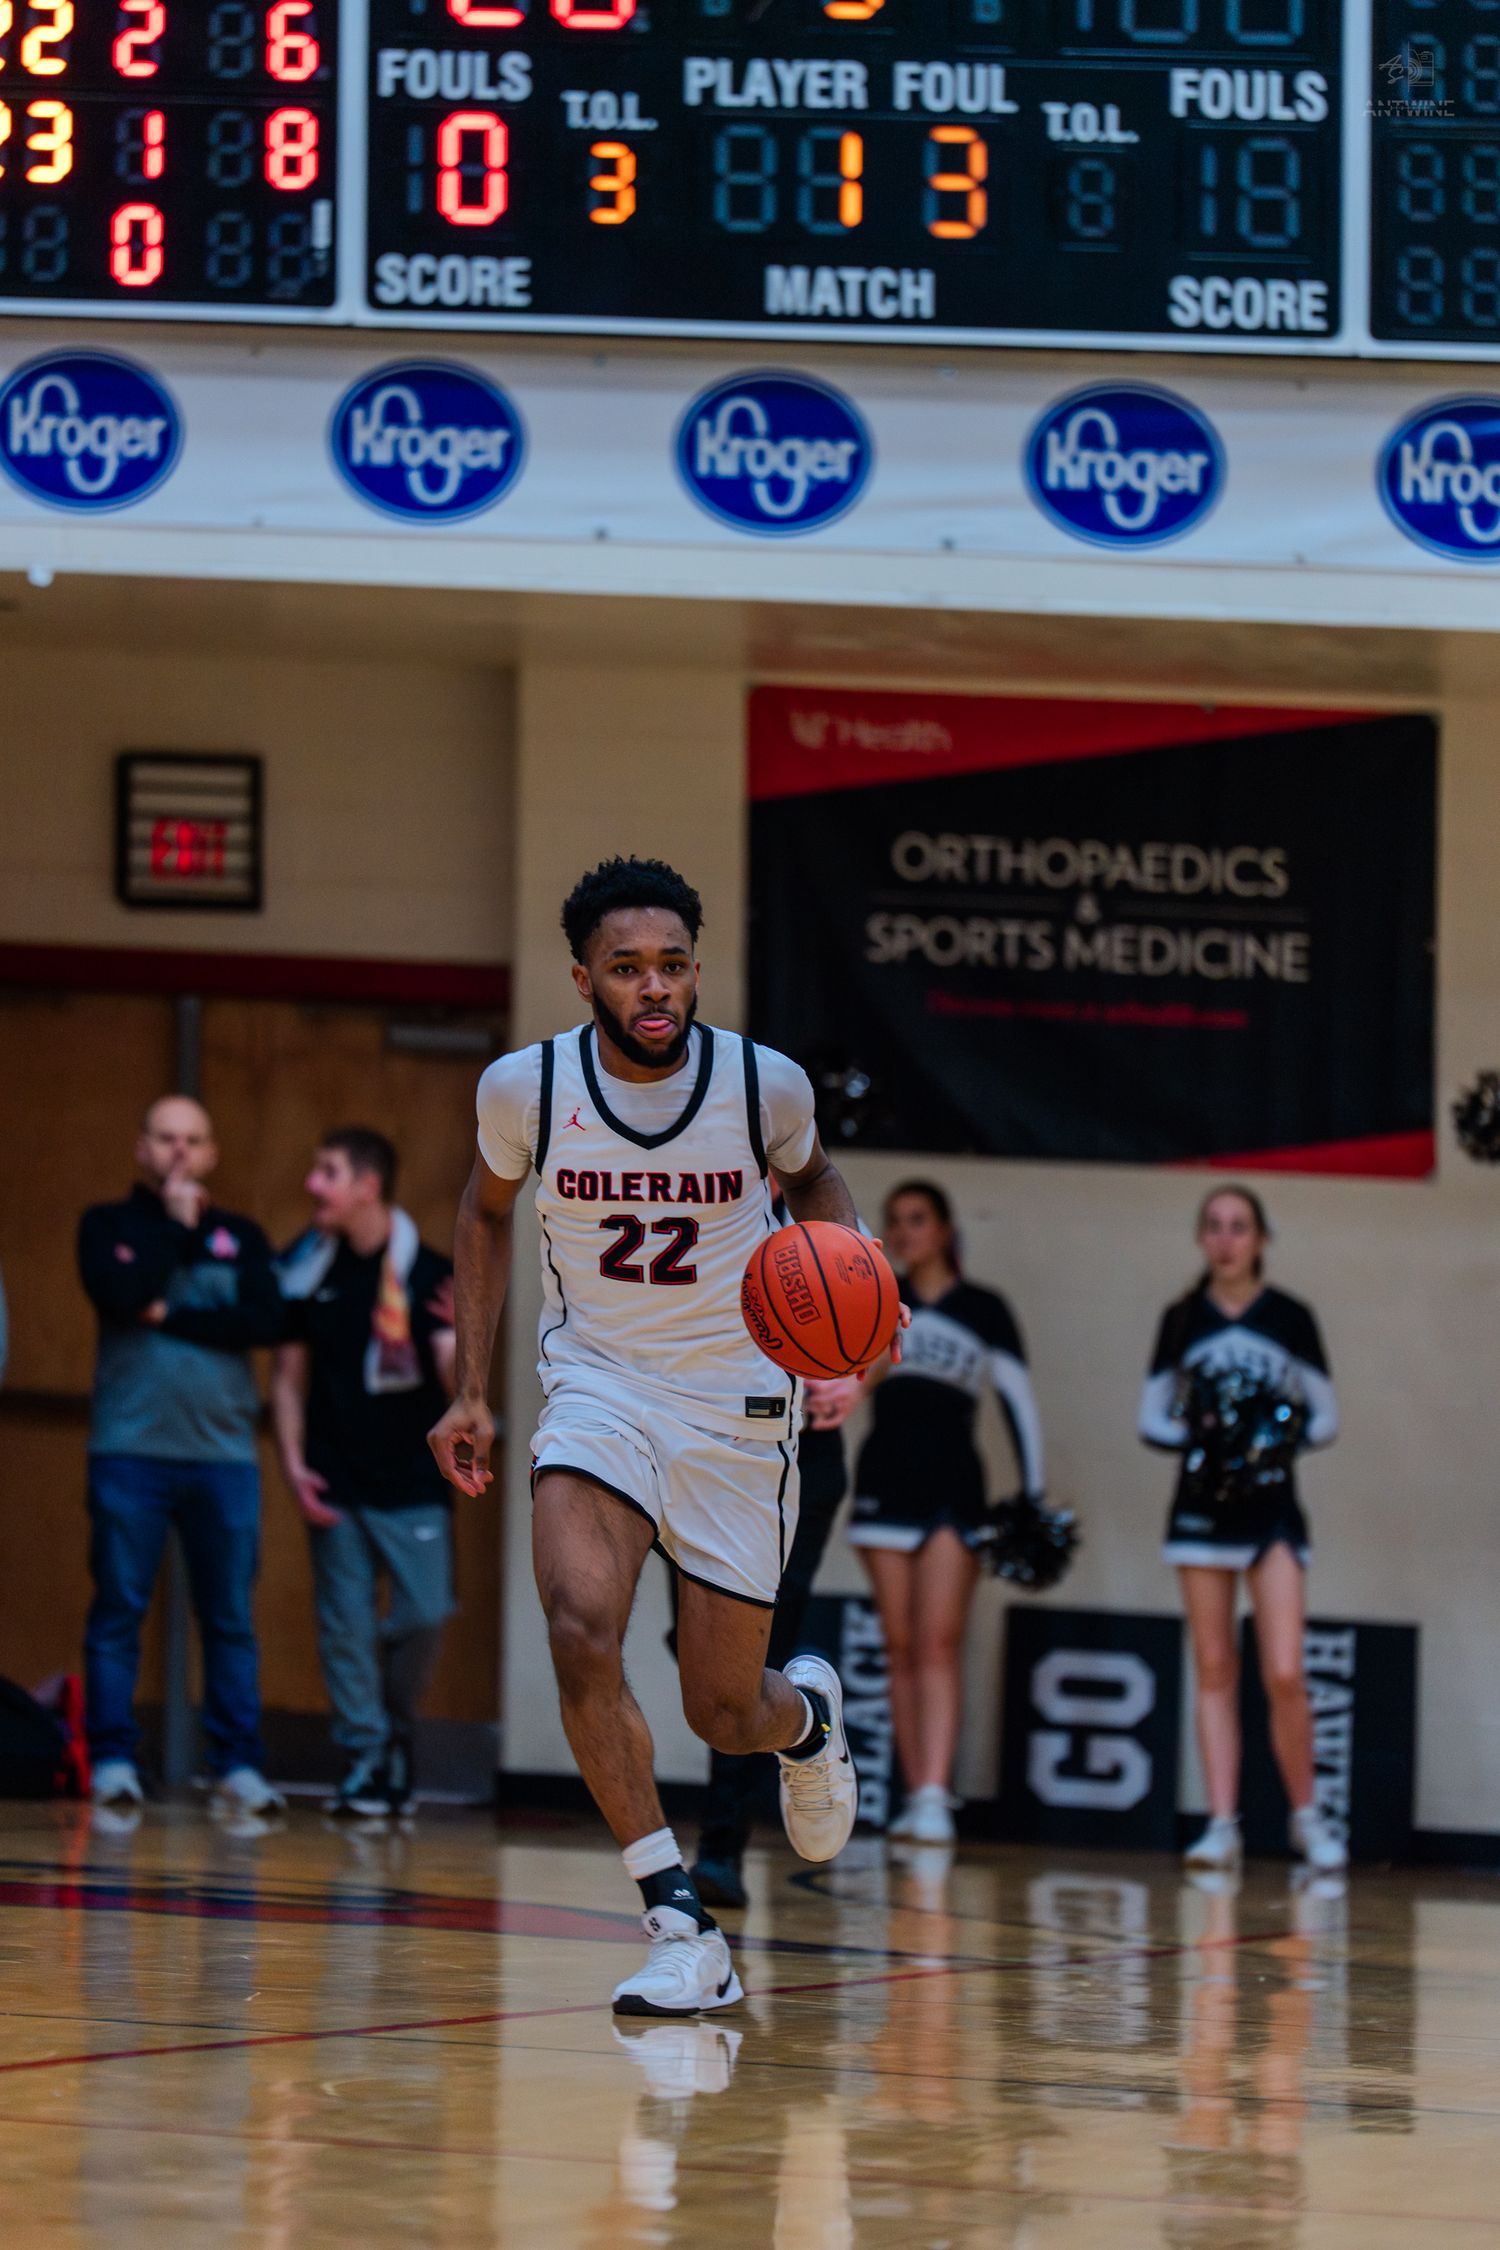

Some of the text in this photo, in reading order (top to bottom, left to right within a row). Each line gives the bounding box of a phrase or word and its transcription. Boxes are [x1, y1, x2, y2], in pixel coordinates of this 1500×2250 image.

[0, 0, 74, 75] 2
[112, 0, 166, 76] 2
[266, 1, 319, 81] 6
[376, 49, 533, 100] FOULS
[683, 56, 1019, 114] PLAYER FOUL
[1170, 67, 1328, 122] FOULS
[0, 100, 73, 183] 3
[143, 110, 165, 179] 1
[264, 107, 319, 190] 8
[437, 111, 508, 226] 0
[589, 141, 636, 224] 3
[110, 203, 164, 286] 0
[374, 252, 532, 306] SCORE
[763, 264, 936, 319] MATCH
[1168, 275, 1329, 330] SCORE
[10, 375, 166, 494] Kroger
[351, 386, 510, 505] Kroger
[696, 397, 858, 517] Kroger
[1046, 408, 1207, 529] Kroger
[891, 830, 1289, 899] ORTHOPAEDICS
[865, 912, 1310, 982] SPORTS MEDICINE
[556, 1168, 743, 1204] COLERAIN
[598, 1214, 699, 1285] 22
[774, 1244, 821, 1326] OHSAA
[742, 1272, 783, 1350] Rawling
[1027, 1648, 1156, 1811] GO
